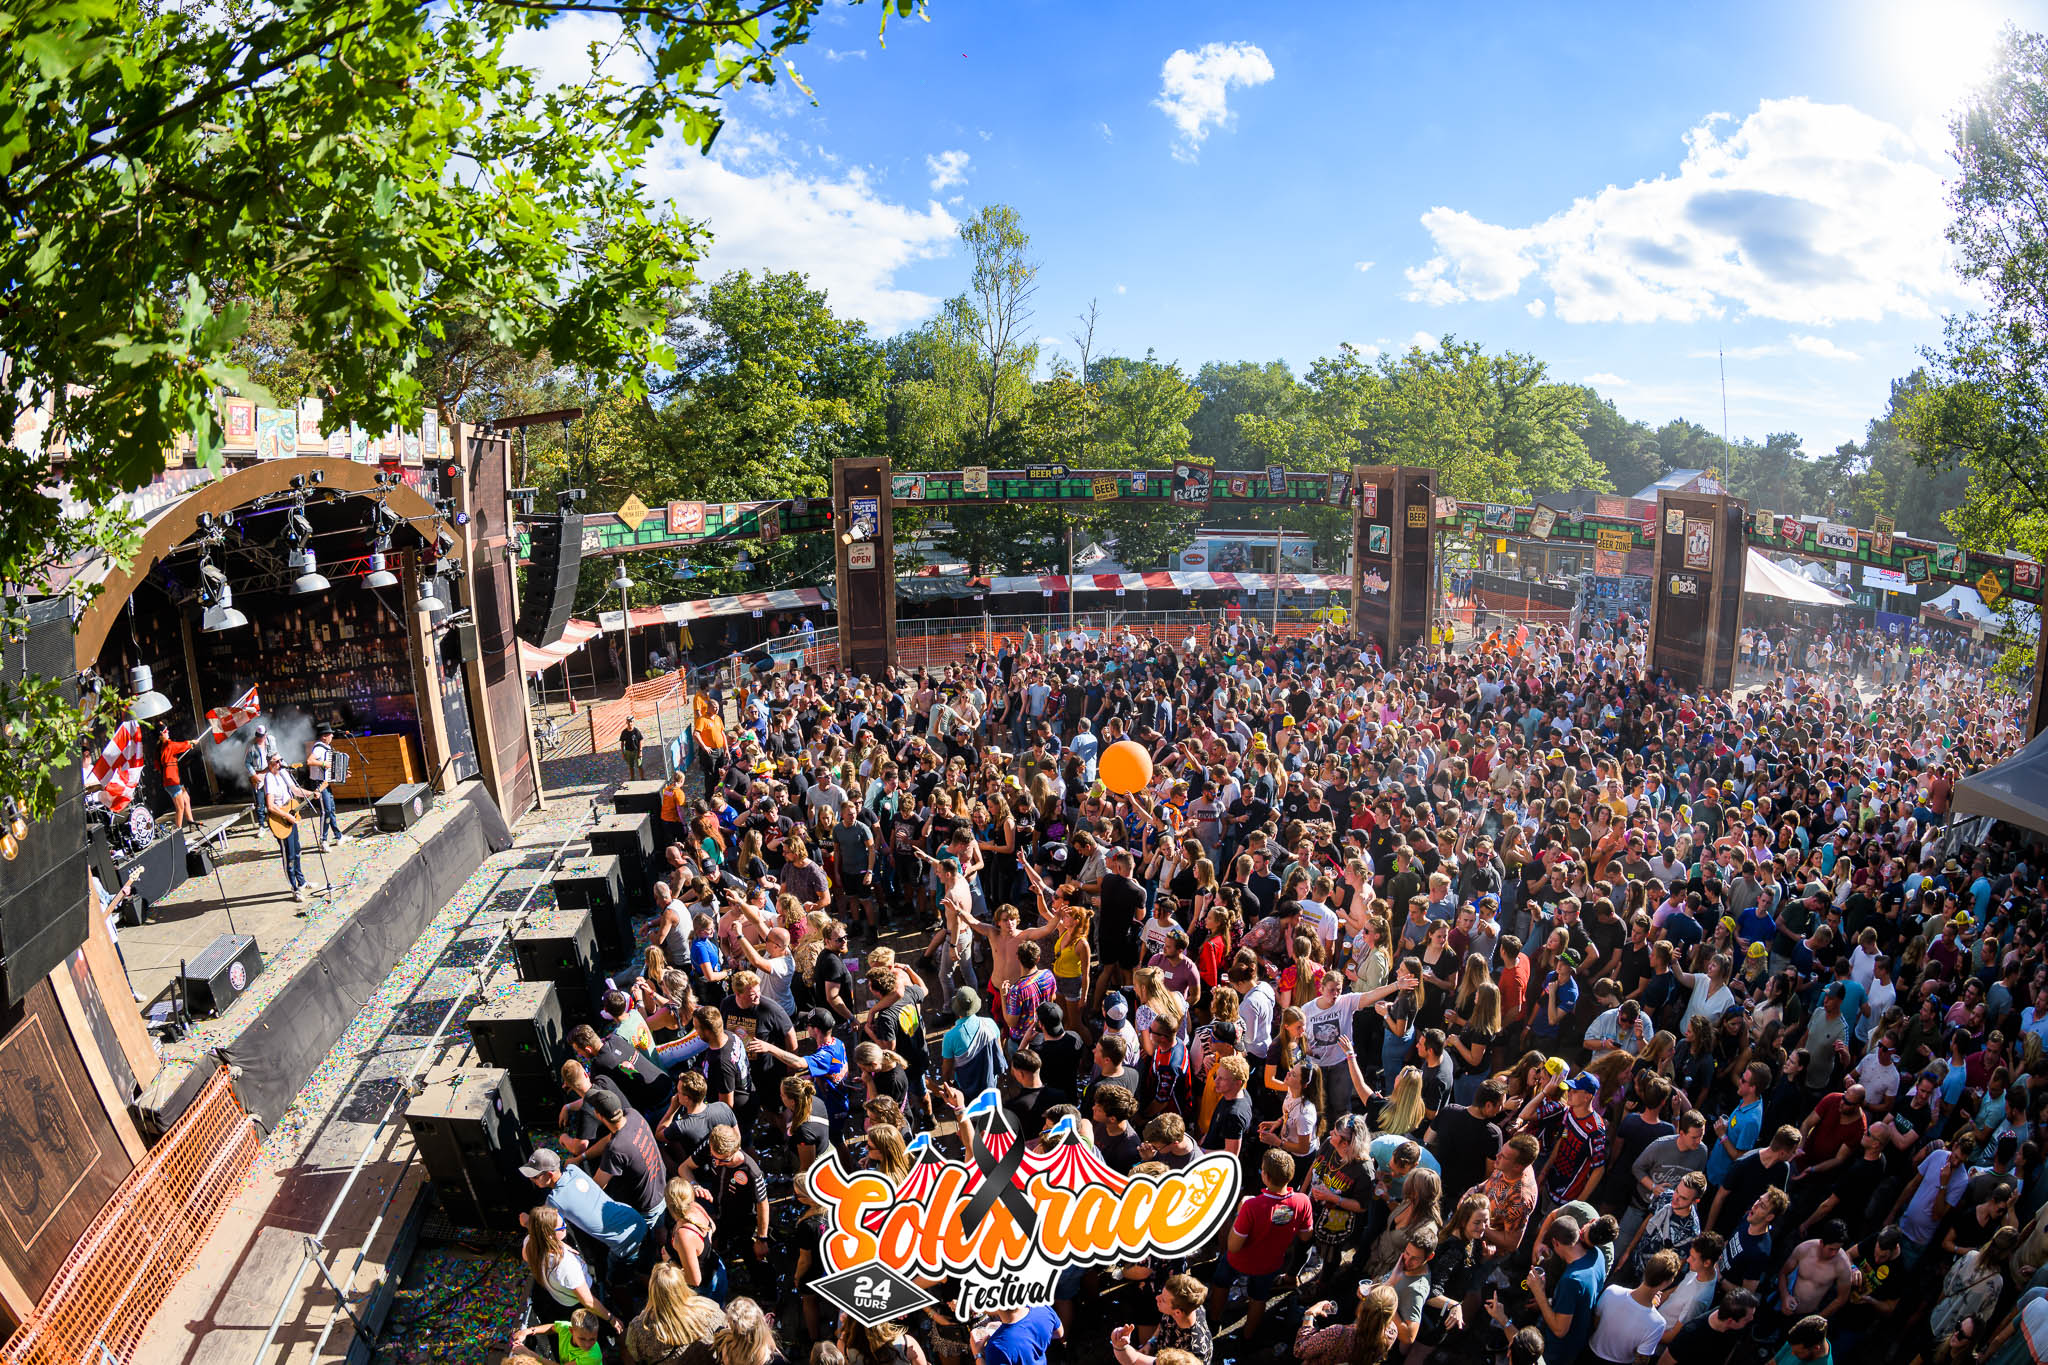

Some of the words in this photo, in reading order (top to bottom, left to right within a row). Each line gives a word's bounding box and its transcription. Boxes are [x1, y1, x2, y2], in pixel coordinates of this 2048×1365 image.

[1030, 469, 1052, 478] BEER
[1094, 483, 1116, 495] BEER
[1174, 488, 1208, 502] Retro
[853, 504, 877, 514] BEER
[1487, 505, 1504, 514] RUM
[1409, 512, 1426, 521] BEER
[1598, 539, 1614, 549] BEER
[1615, 541, 1631, 552] ZONE
[1823, 533, 1854, 548] BEER
[851, 555, 871, 564] OPEN
[1679, 580, 1697, 594] BEER
